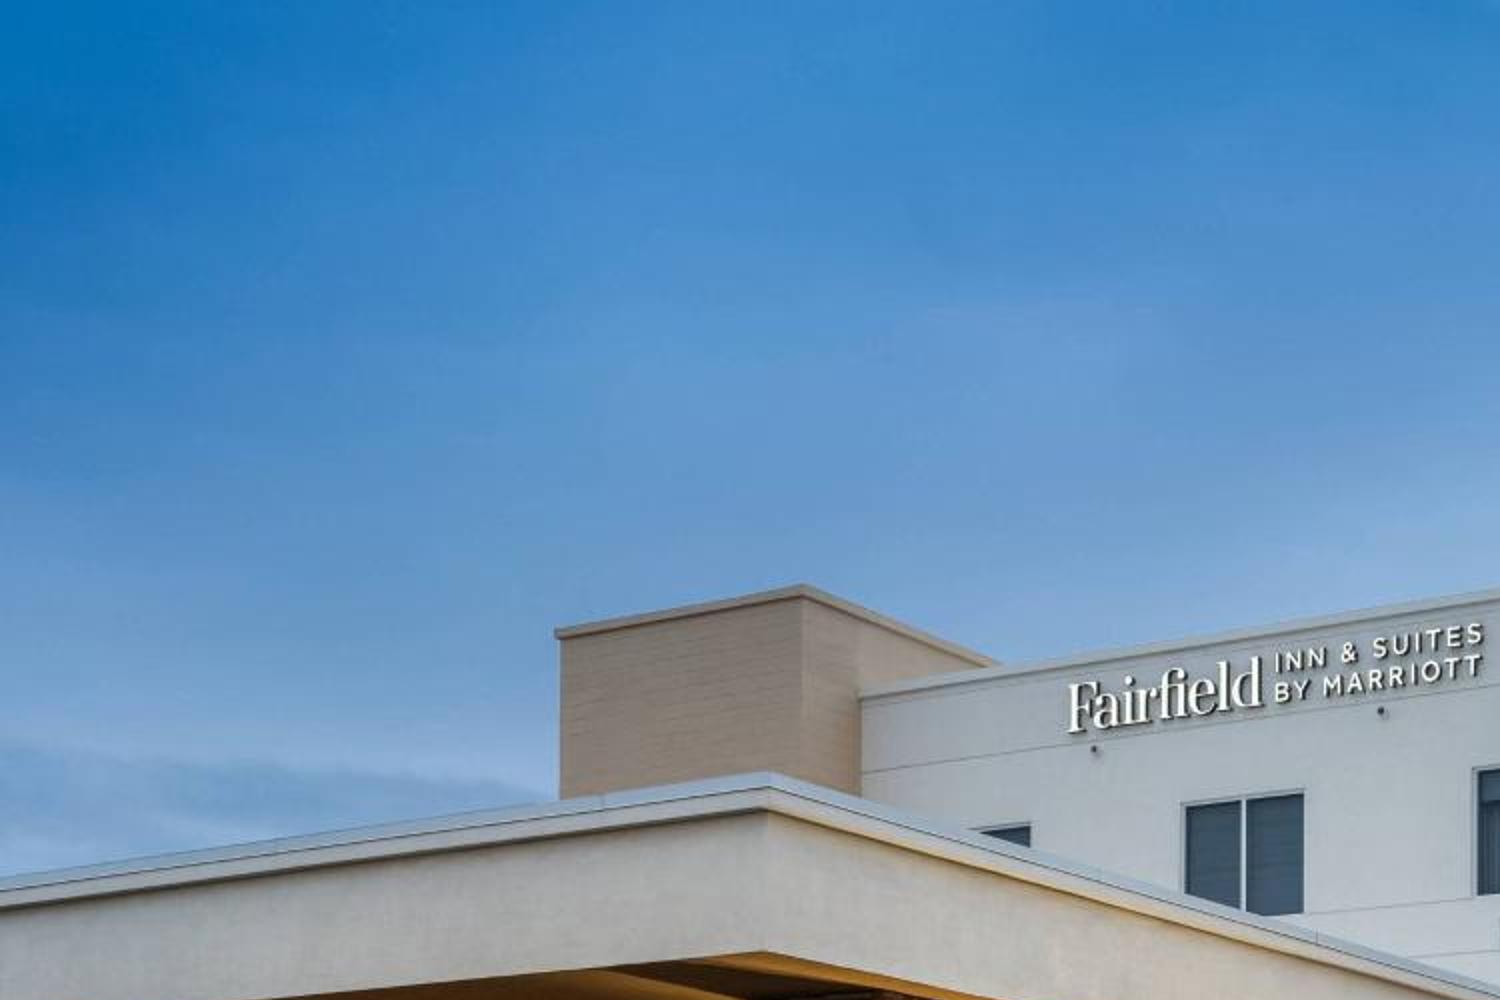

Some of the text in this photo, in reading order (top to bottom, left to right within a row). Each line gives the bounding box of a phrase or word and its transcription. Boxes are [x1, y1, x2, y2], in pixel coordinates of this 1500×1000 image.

[1275, 623, 1484, 673] INN & SUITES
[1068, 656, 1264, 733] Fairfield
[1275, 654, 1483, 702] BY MARRIOTT
